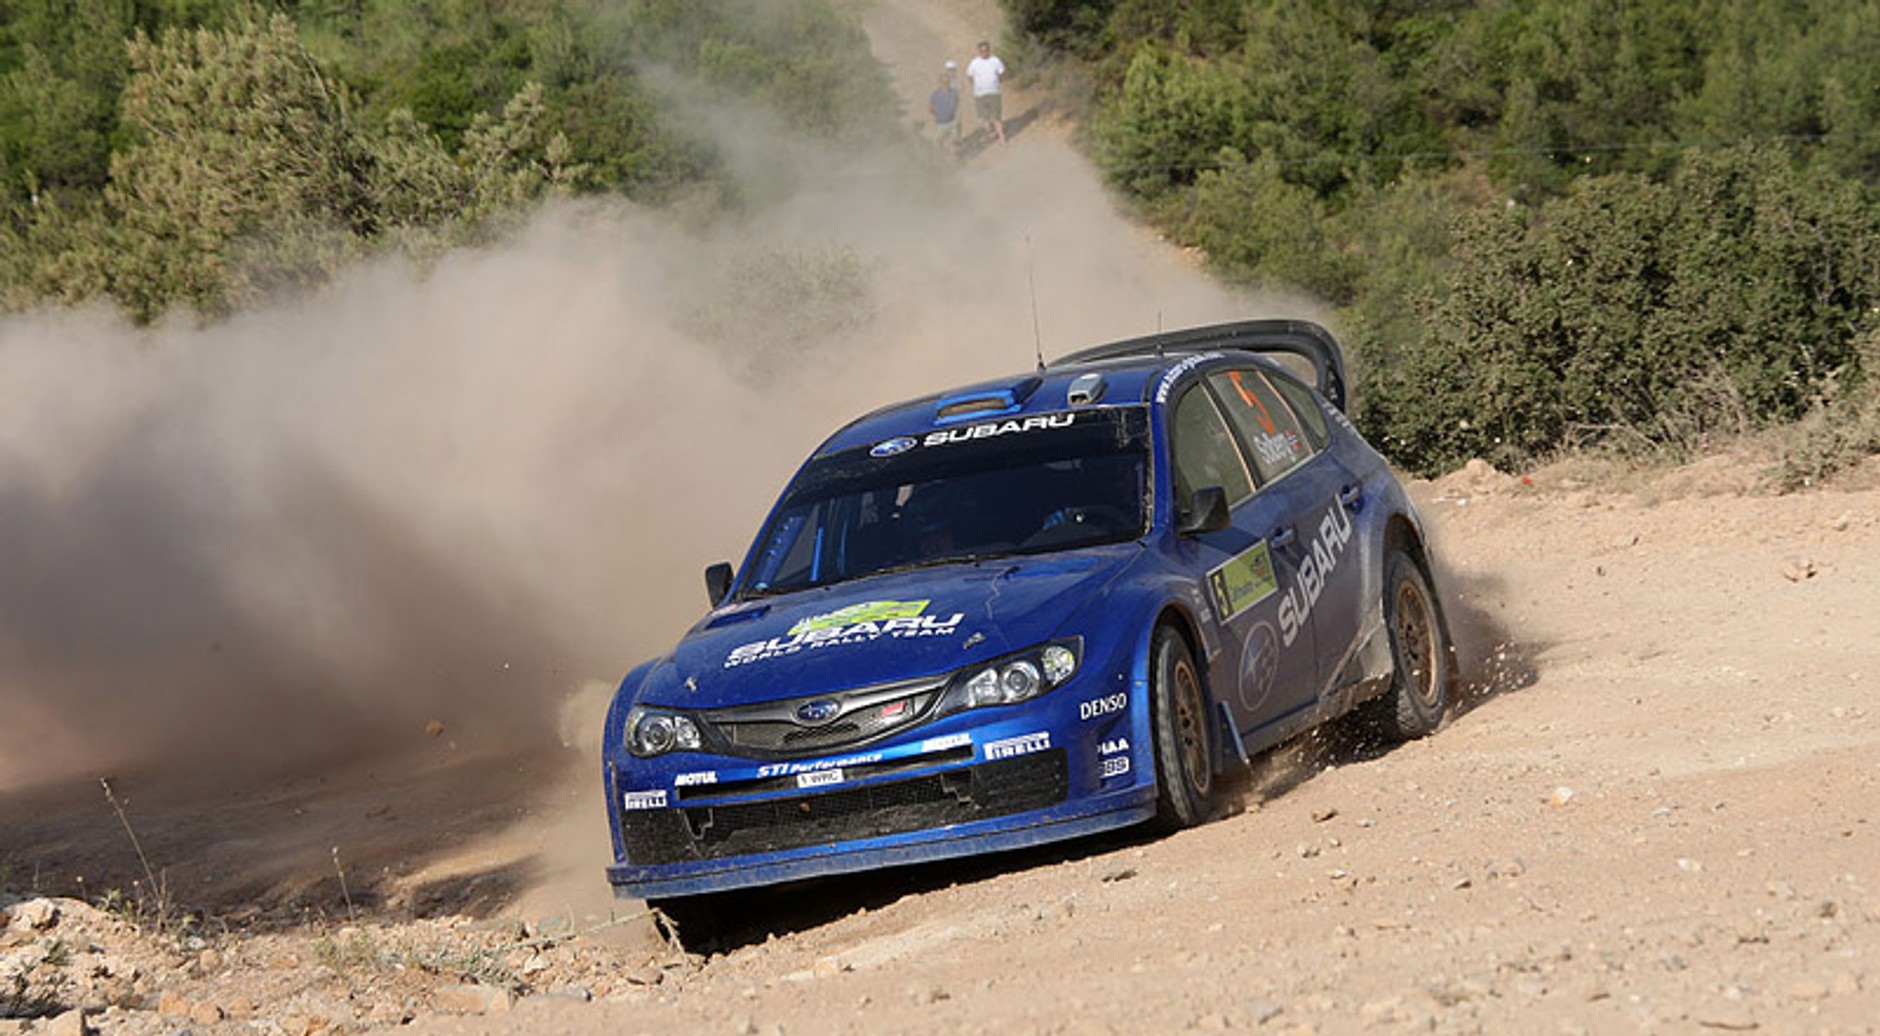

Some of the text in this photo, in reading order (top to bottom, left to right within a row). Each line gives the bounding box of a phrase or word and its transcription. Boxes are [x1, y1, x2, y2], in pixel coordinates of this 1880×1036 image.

[1226, 370, 1276, 438] 5
[923, 413, 1076, 448] SUBARU
[1278, 493, 1352, 648] SUBARU
[723, 626, 956, 669] WORLD RALLY TEAM
[728, 613, 965, 661] SUBARU
[1080, 692, 1127, 720] DENSO
[674, 770, 718, 786] MOTUL
